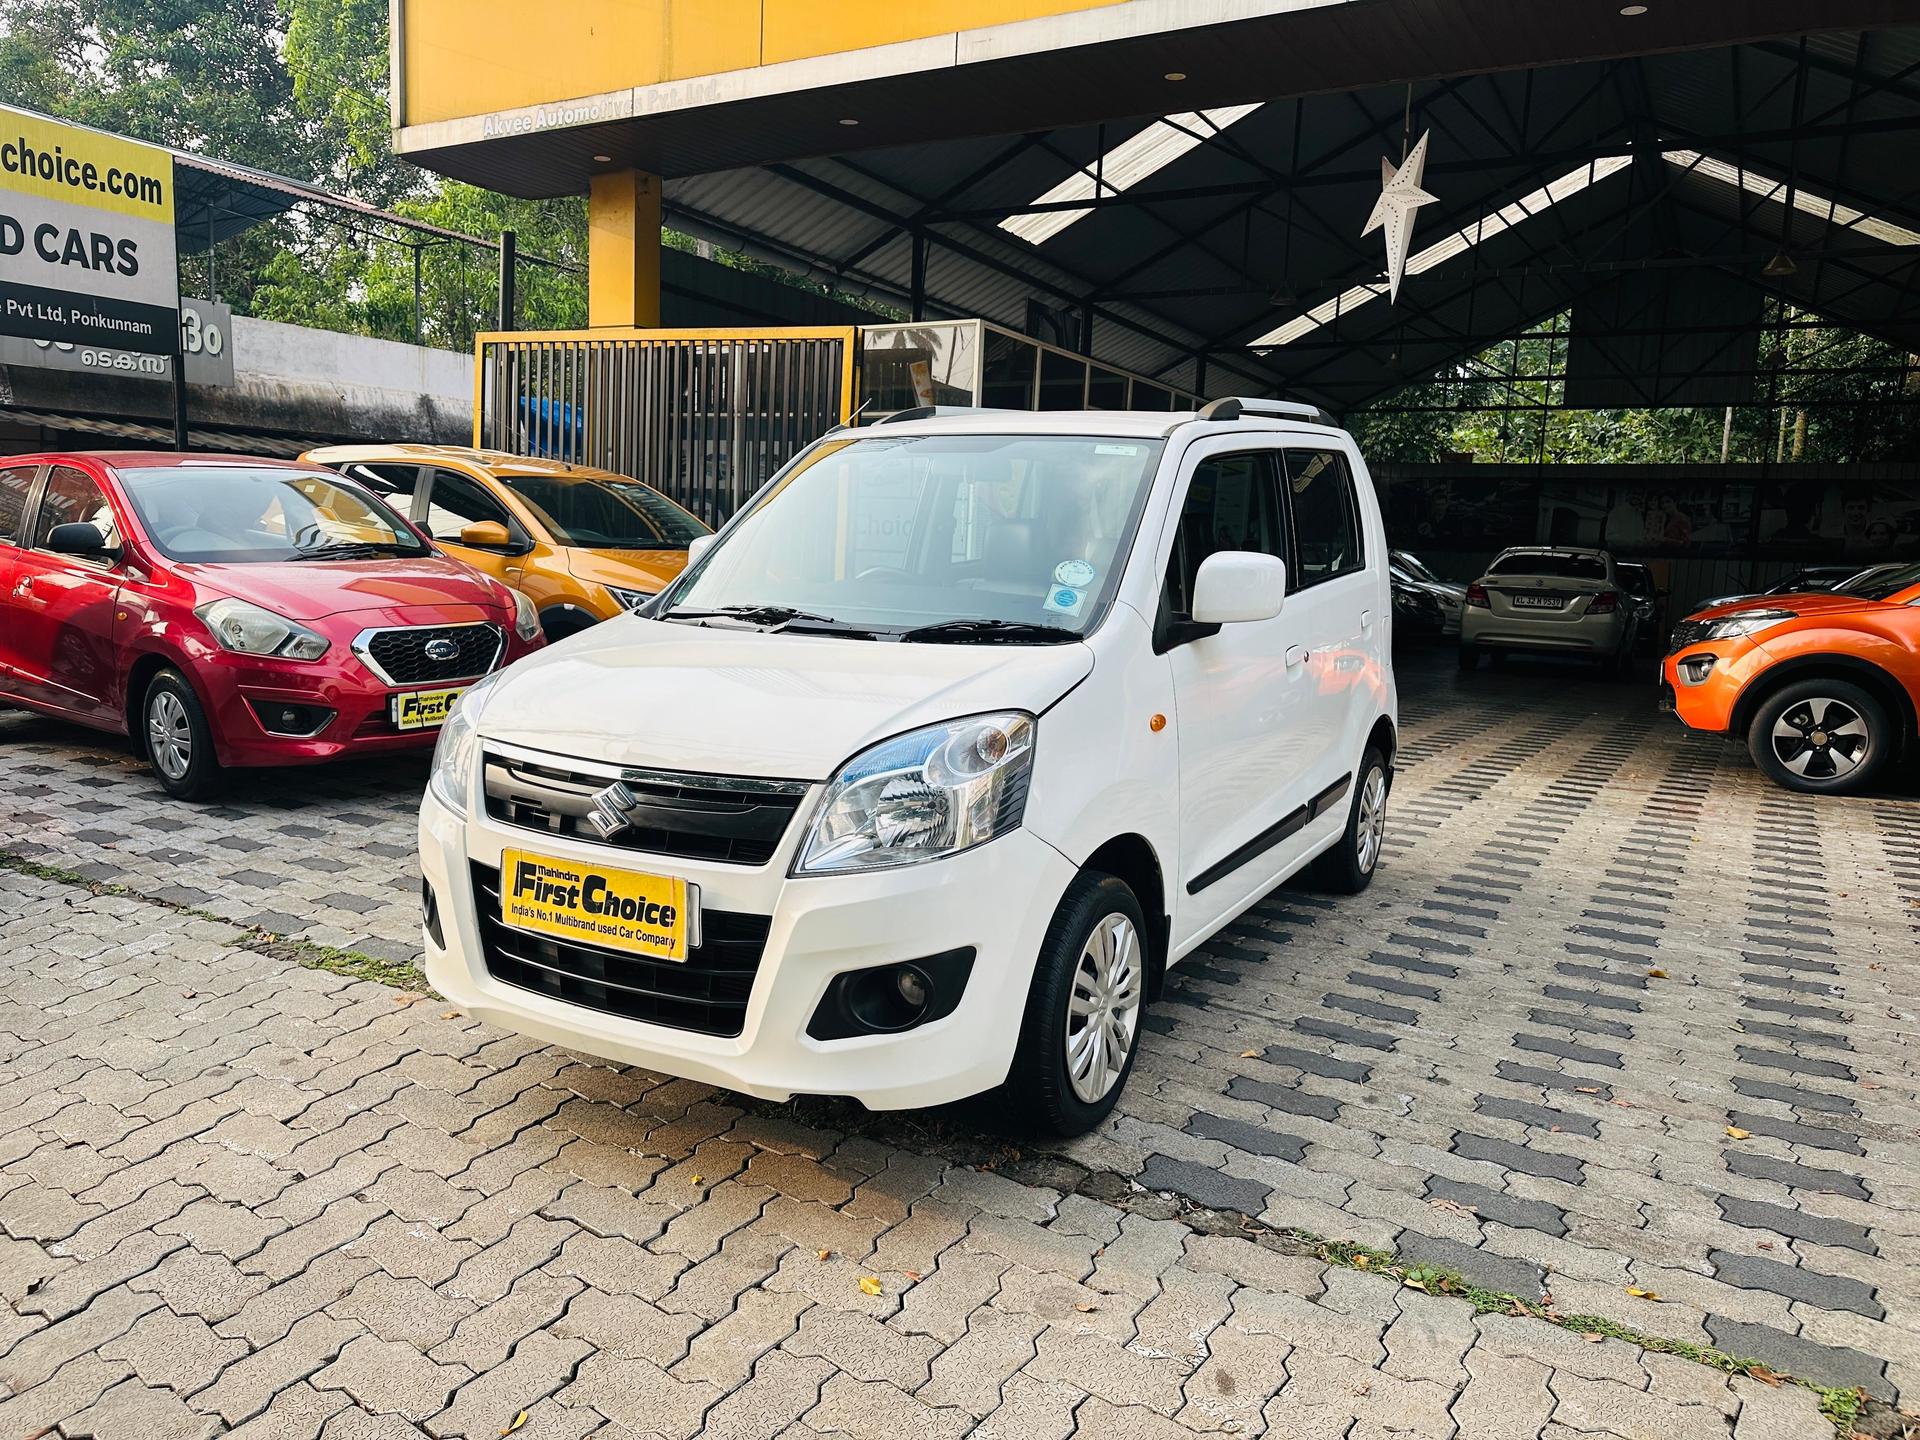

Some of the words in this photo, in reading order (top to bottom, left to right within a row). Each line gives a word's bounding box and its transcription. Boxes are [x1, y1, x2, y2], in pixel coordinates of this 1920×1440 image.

[484, 118, 531, 137] Akvee
[1, 137, 162, 205] choice.com
[34, 223, 139, 277] CARS
[6, 299, 33, 318] Pvt
[37, 303, 67, 325] Ltd,
[71, 309, 152, 335] Ponkunnam
[403, 698, 444, 717] First
[513, 861, 580, 909] First
[582, 875, 676, 927] Choice
[538, 865, 580, 882] Mahindra
[511, 903, 535, 918] India's
[537, 907, 553, 922] No.1
[555, 911, 596, 932] Multibrand
[598, 921, 617, 936] used
[619, 926, 633, 939] Car
[635, 930, 676, 949] Company
